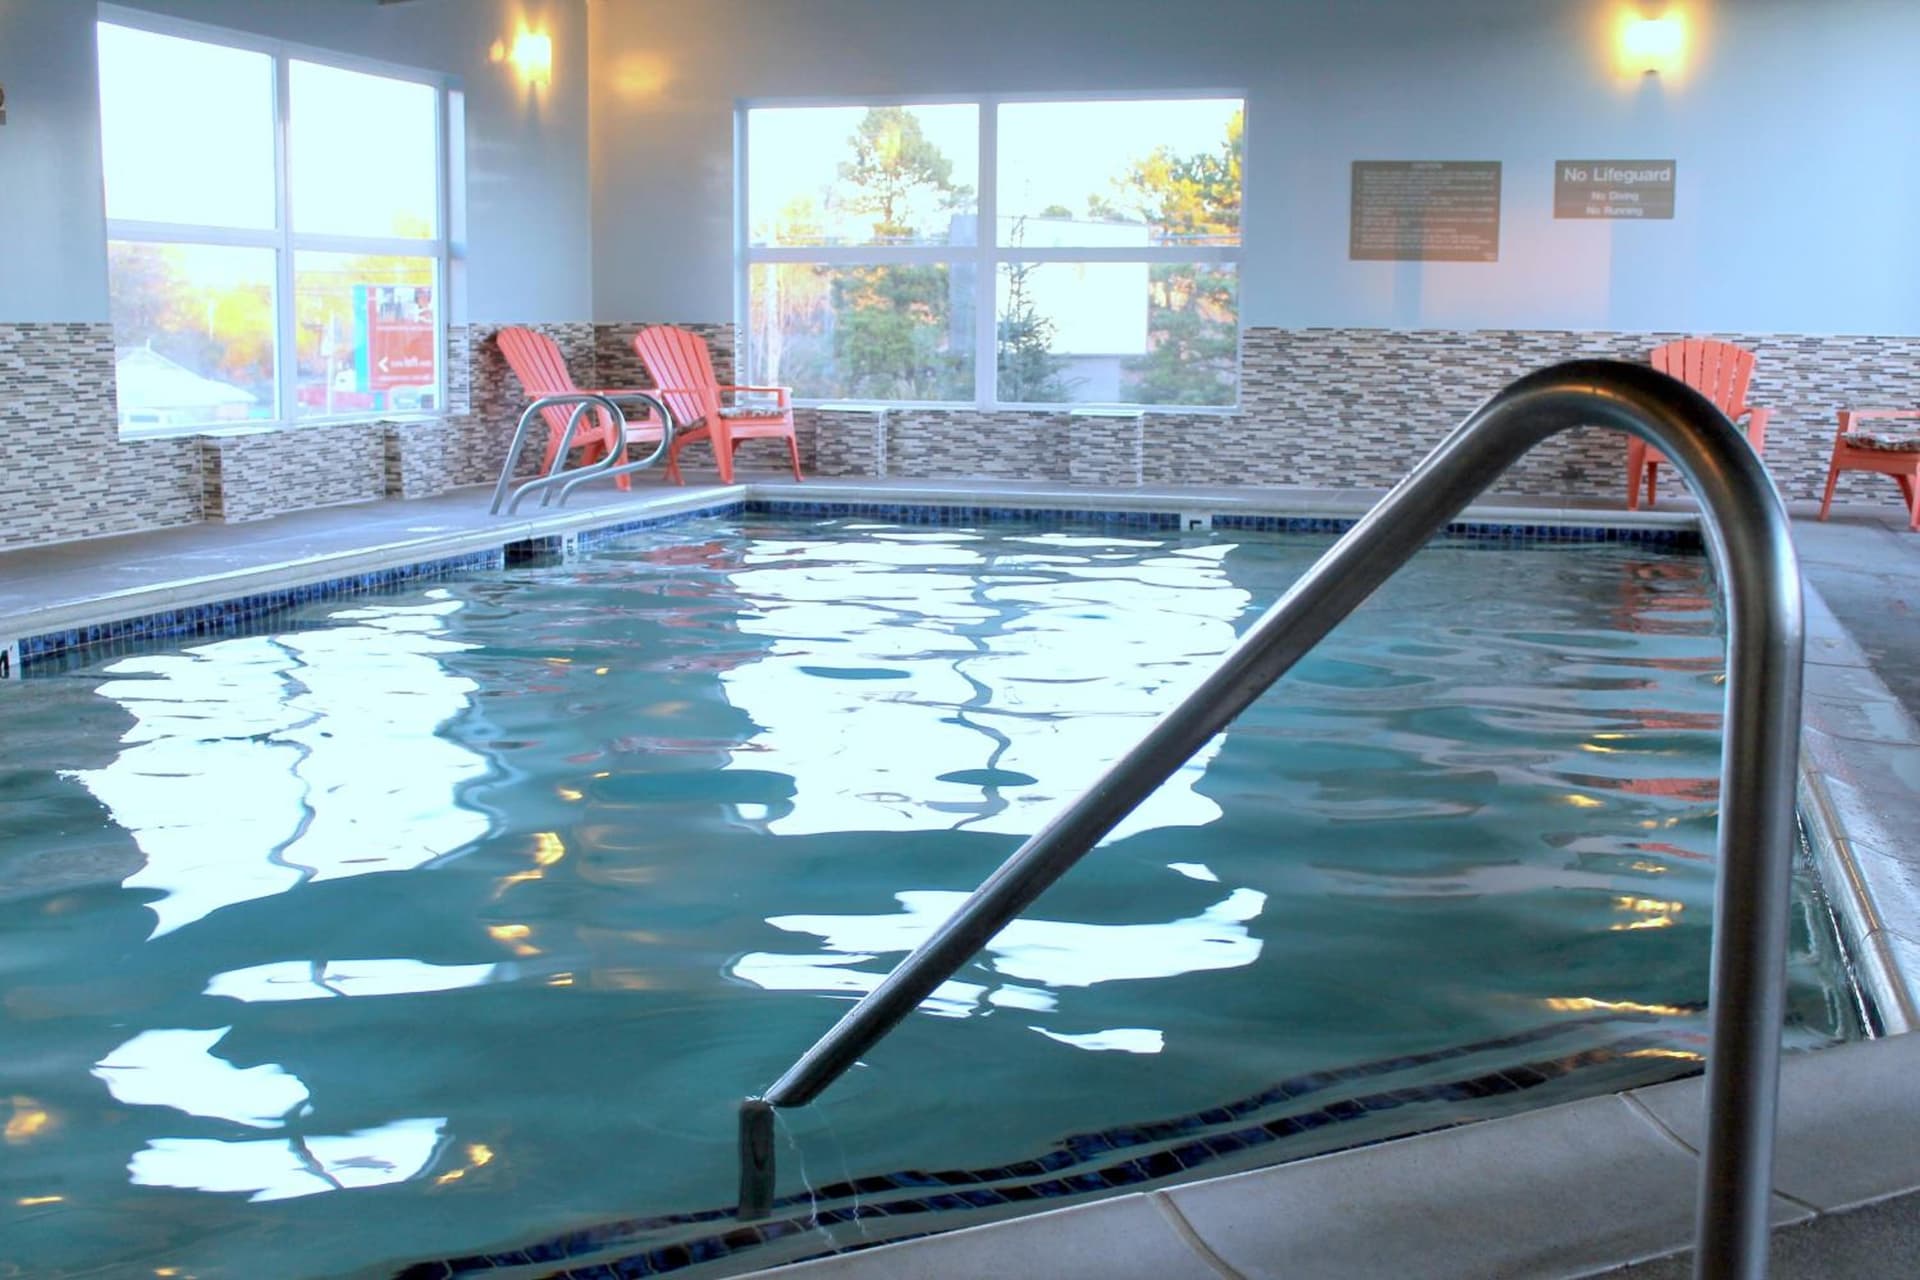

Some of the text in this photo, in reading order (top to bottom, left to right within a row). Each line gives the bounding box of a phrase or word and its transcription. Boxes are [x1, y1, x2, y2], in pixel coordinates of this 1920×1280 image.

[1564, 168, 1671, 184] No Lifeguard
[1591, 191, 1639, 202] No Diving
[1586, 207, 1643, 217] No Running
